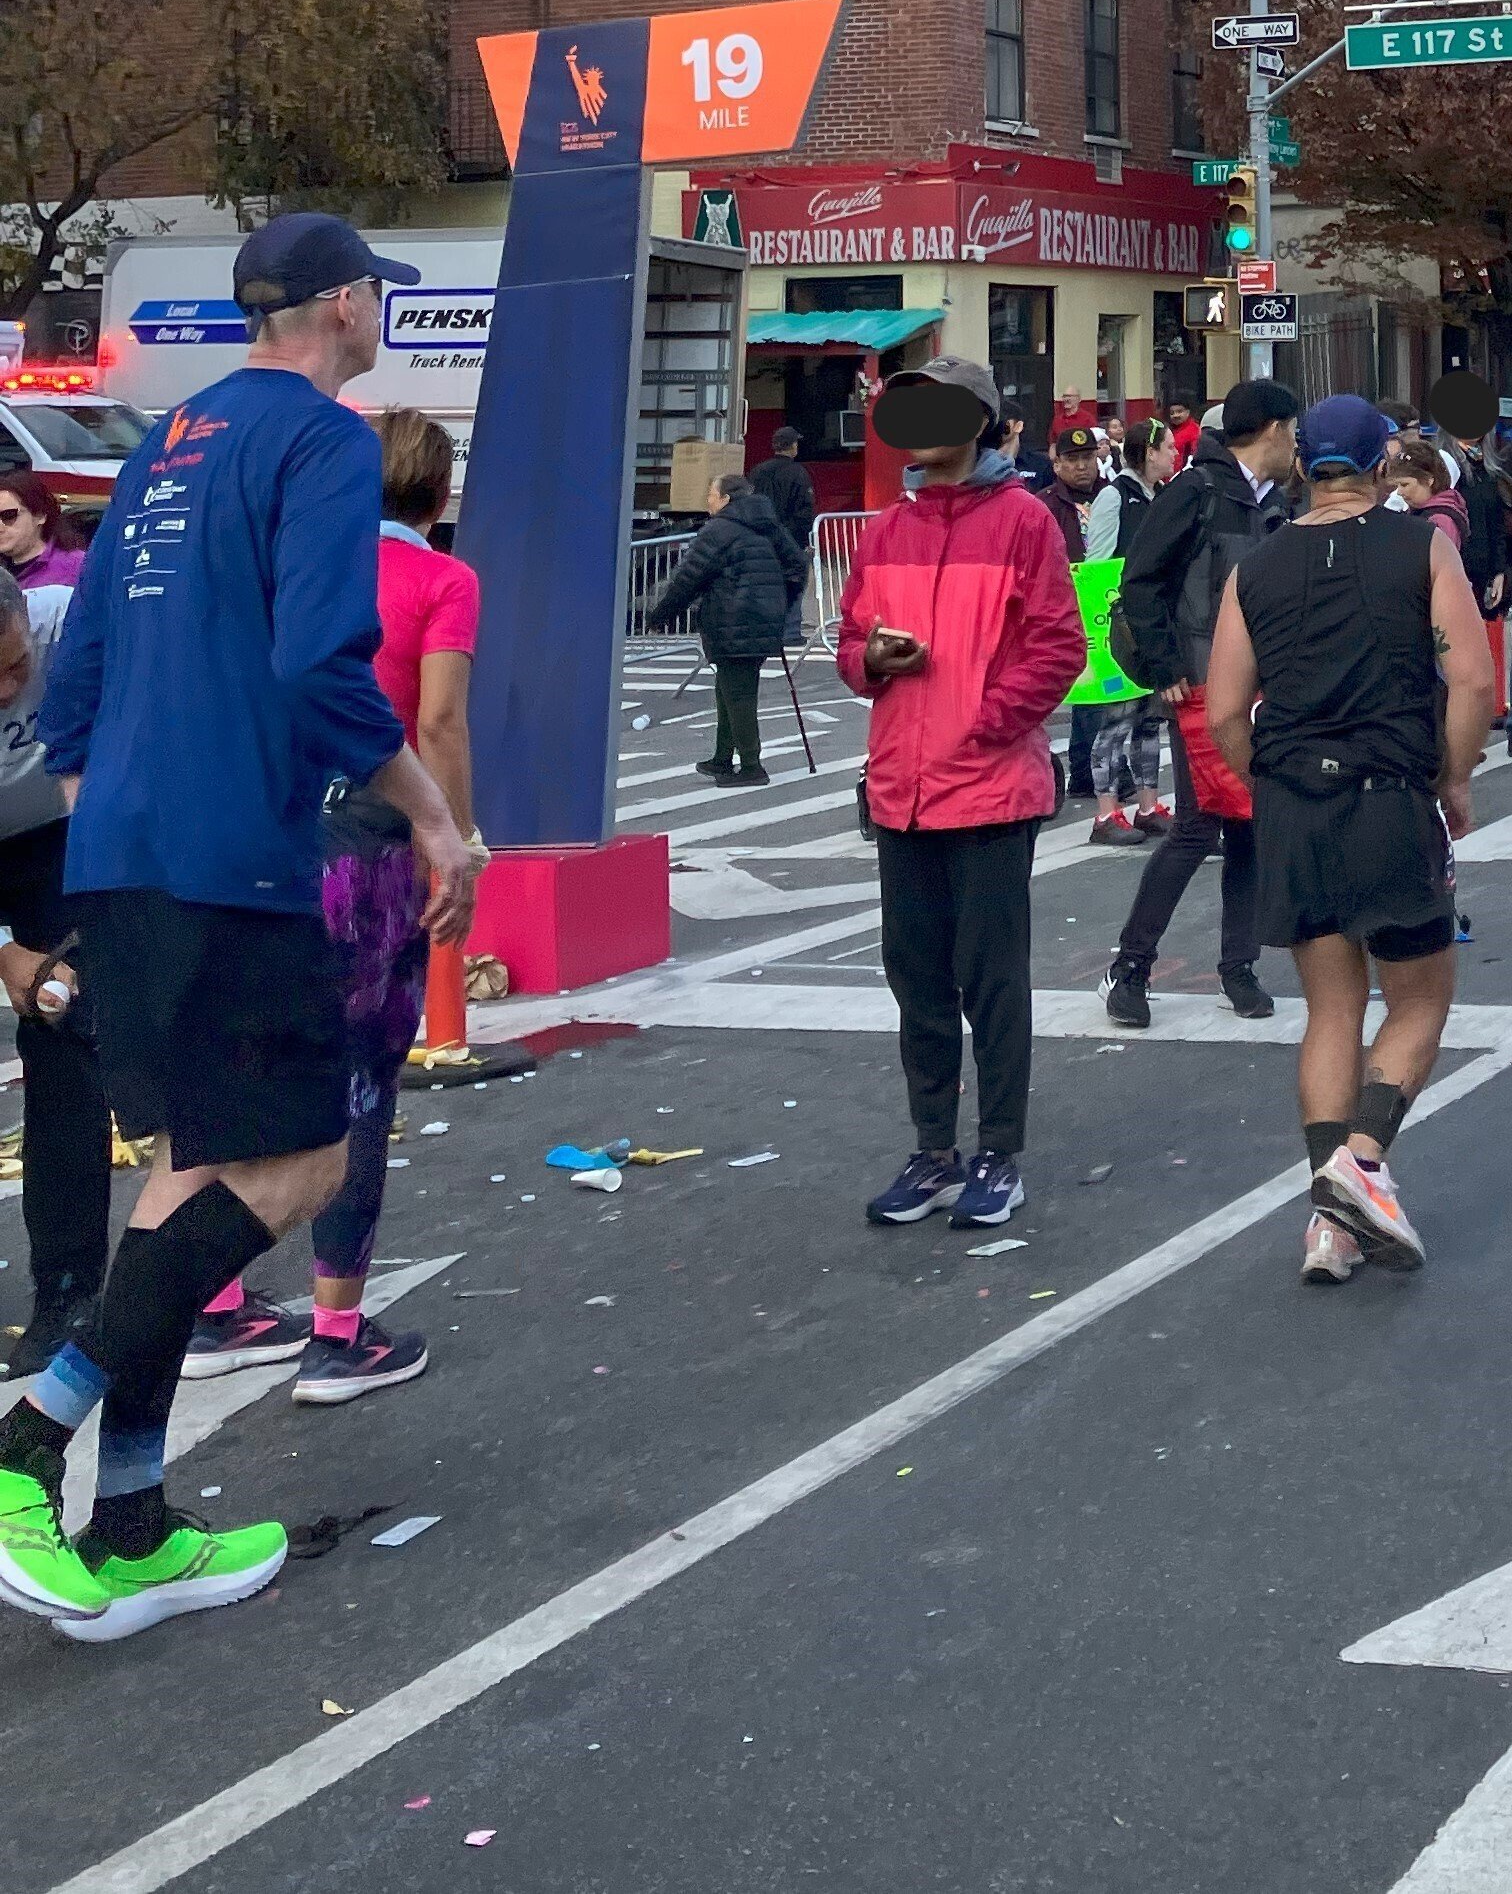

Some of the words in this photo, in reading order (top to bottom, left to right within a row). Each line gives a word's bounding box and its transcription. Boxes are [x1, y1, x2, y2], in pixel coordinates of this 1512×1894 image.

[1222, 26, 1250, 39] ONE
[1264, 24, 1289, 36] WAY
[1382, 32, 1401, 57] E
[1412, 29, 1455, 56] 117
[1467, 27, 1504, 52] St
[681, 33, 763, 102] 19
[699, 106, 750, 131] MILE
[1200, 165, 1208, 182] E
[1213, 164, 1229, 182] 117
[807, 186, 883, 226] Guajillo
[967, 194, 1034, 254] Guajillo
[749, 227, 886, 265] RESTAURANT
[890, 227, 907, 262] &
[912, 226, 955, 261] BAR
[1039, 208, 1150, 269] RESTAURANT
[1153, 228, 1164, 271] &
[1168, 222, 1199, 273] BAR
[394, 308, 494, 330] PENSK
[1245, 325, 1265, 337] BIKE
[1270, 324, 1293, 336] PATH
[409, 354, 448, 368] Truck
[449, 354, 485, 368] Rent
